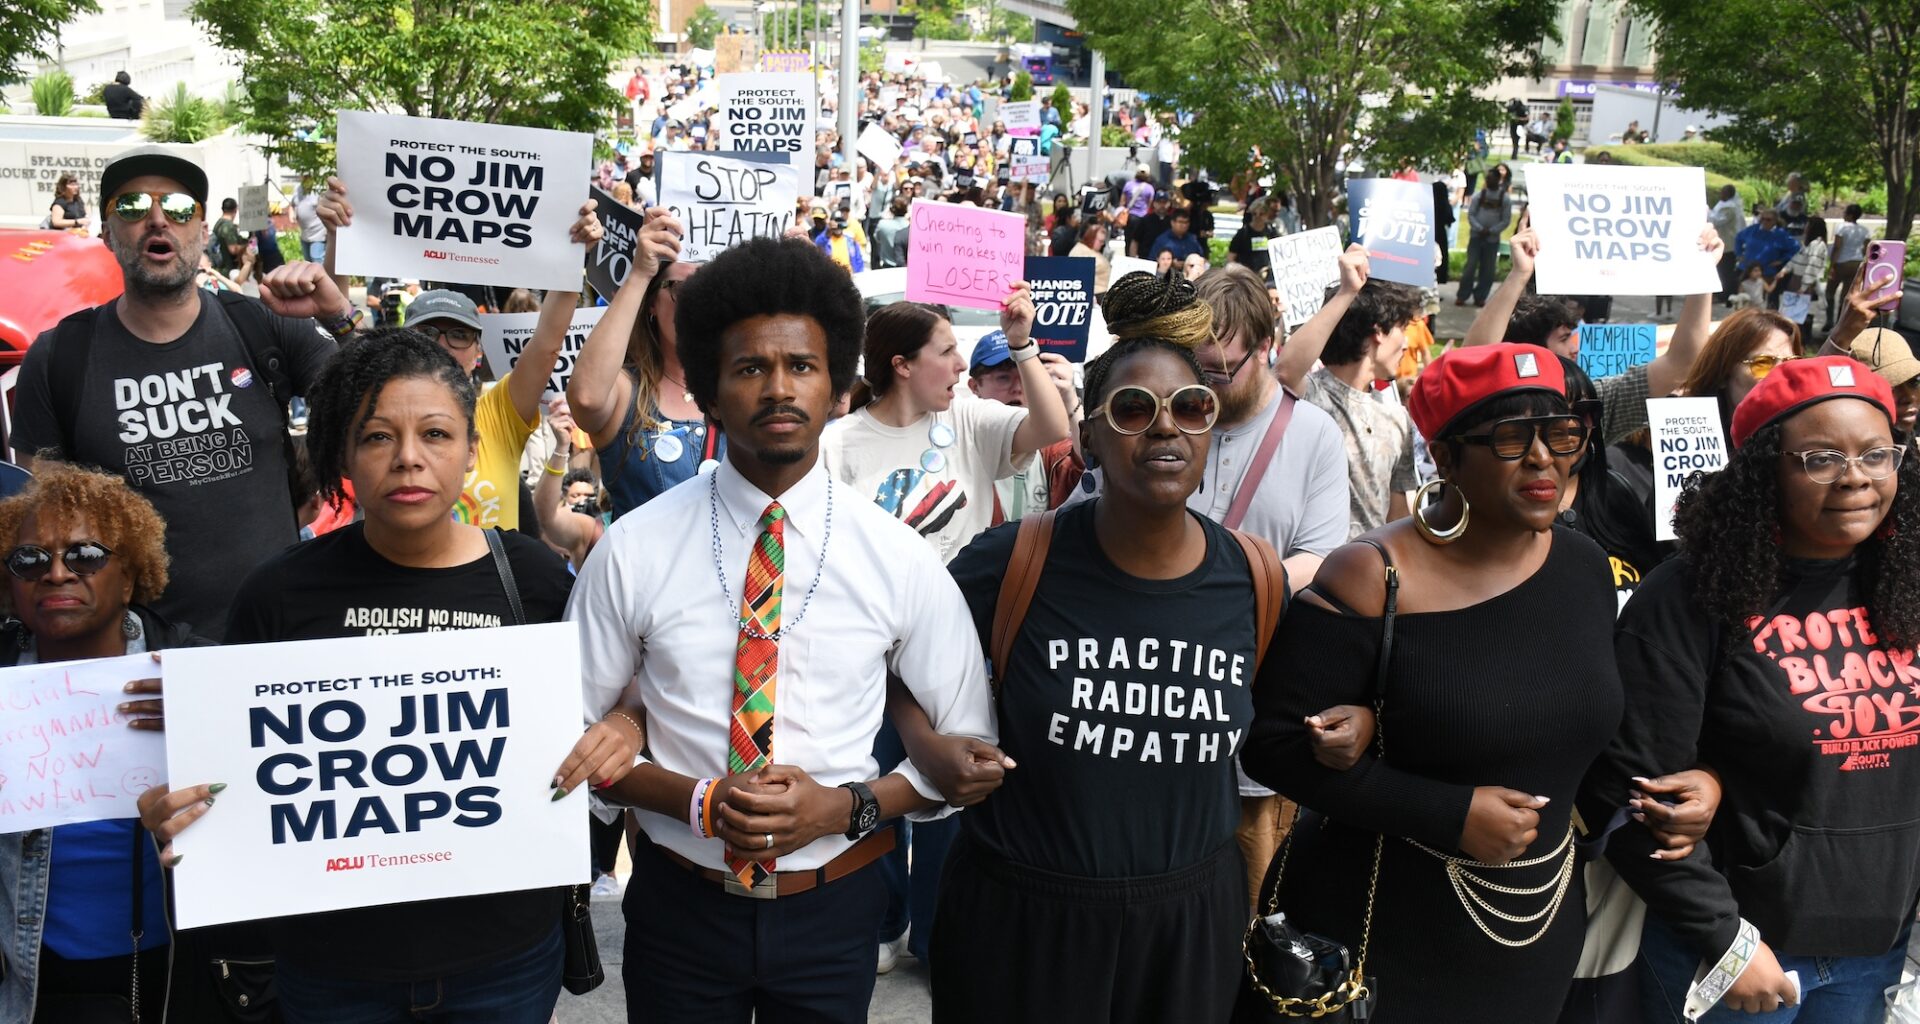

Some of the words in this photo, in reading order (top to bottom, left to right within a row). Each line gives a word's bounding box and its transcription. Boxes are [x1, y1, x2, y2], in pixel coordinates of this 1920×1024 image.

[738, 89, 796, 97] PROTECT
[1565, 81, 1586, 94] Bus
[728, 107, 762, 120] NO
[769, 107, 806, 121] JIM
[729, 98, 754, 106] THE
[729, 122, 805, 136] CROW
[390, 139, 455, 153] PROTECT
[459, 145, 486, 156] THE
[490, 148, 541, 161] SOUTH:
[733, 138, 803, 152] MAPS
[0, 167, 37, 179] OUSE
[40, 169, 57, 180] OF
[31, 155, 92, 168] SPEAKER
[385, 152, 456, 183] NO
[468, 160, 544, 192] JIM
[695, 160, 777, 201] STOP
[1563, 182, 1609, 190] PROTECT
[1612, 184, 1628, 192] THE
[386, 182, 540, 220] CROW
[1563, 193, 1611, 213] NO
[1621, 195, 1673, 216] JIM
[393, 211, 533, 249] MAPS
[606, 214, 638, 243] HAN
[915, 206, 982, 243] Cheating
[989, 222, 1006, 239] to
[1357, 217, 1431, 247] VOTE
[1568, 216, 1672, 239] CROW
[423, 249, 447, 260] ACLU
[448, 251, 501, 265] Tennessee
[919, 240, 943, 254] win
[953, 244, 996, 261] makes
[1000, 250, 1021, 267] you
[1273, 236, 1301, 263] NOT
[1575, 240, 1672, 262] MAPS
[596, 241, 633, 287] VO
[926, 262, 1014, 295] LOSERS
[1030, 279, 1083, 291] HANDS
[1056, 290, 1087, 301] OUR
[568, 323, 594, 331] OUTH
[1579, 326, 1651, 352] MEMPHIS
[114, 361, 225, 411] DON'T
[117, 393, 243, 444] SUCK
[1660, 427, 1680, 436] THE
[1665, 416, 1708, 426] PROTECT
[125, 444, 153, 464] AT
[157, 431, 227, 459] BEING
[232, 427, 250, 445] A
[1660, 437, 1688, 453] NO
[1694, 436, 1720, 451] JIM
[128, 444, 253, 486] PERSON
[1663, 453, 1722, 471] CROW
[344, 607, 424, 628] ABOLISH
[428, 609, 449, 626] NO
[452, 611, 502, 628] HUMAN
[1744, 606, 1879, 654] PROTE
[1048, 636, 1245, 687] PRACTICE
[1778, 647, 1920, 695] BLACK
[255, 677, 362, 697] PROTECT
[369, 673, 414, 688] THE
[421, 666, 502, 684] SOUTH:
[1071, 676, 1231, 722] RADICAL
[249, 699, 367, 748] NO
[390, 687, 510, 738] JIM
[1826, 692, 1906, 739] JOY
[1047, 711, 1242, 764] EMPATHY
[1821, 740, 1850, 755] BUILD
[1851, 737, 1881, 753] BLACK
[1882, 734, 1918, 750] POWER
[256, 736, 508, 797] CROW
[270, 785, 503, 845] MAPS
[326, 856, 365, 872] ACLU
[367, 851, 453, 868] Tennessee
